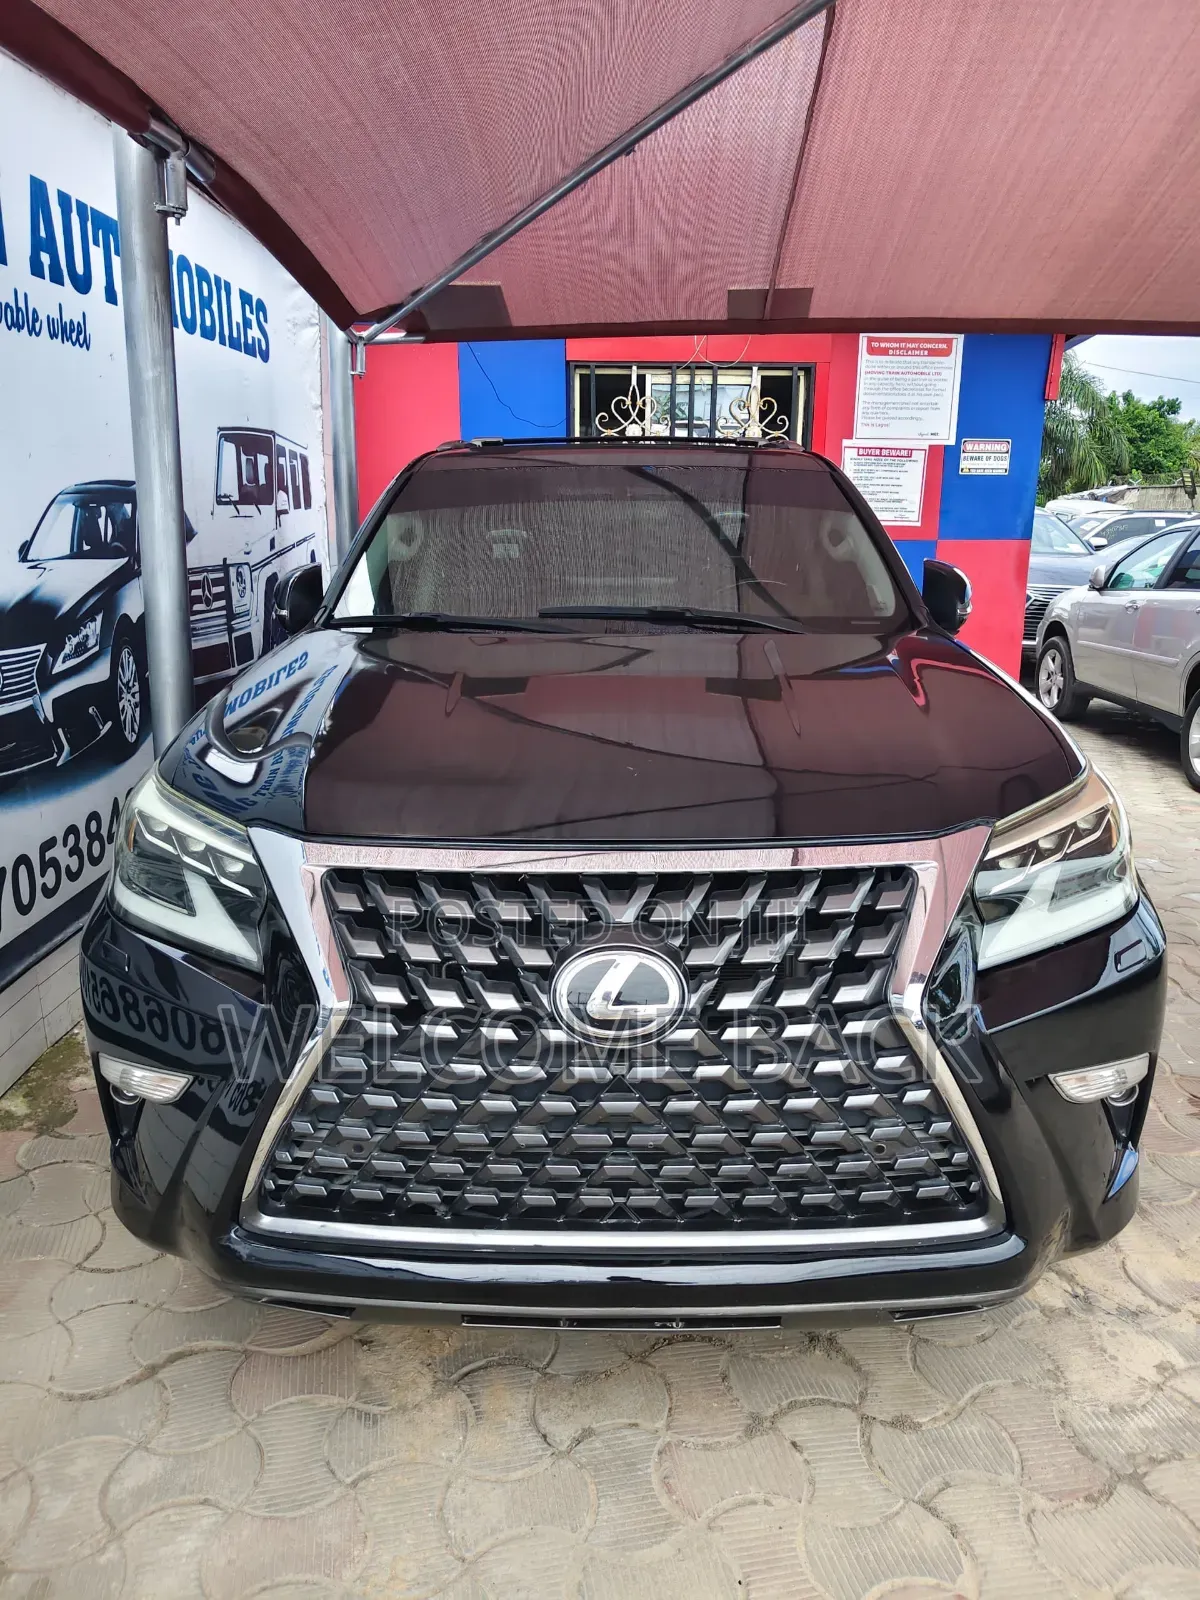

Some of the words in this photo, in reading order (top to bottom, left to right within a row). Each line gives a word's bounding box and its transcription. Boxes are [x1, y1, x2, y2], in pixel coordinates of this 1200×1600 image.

[0, 287, 43, 337] able
[46, 302, 91, 351] wheel
[965, 443, 1007, 451] WARNING
[0, 787, 134, 930] 05384
